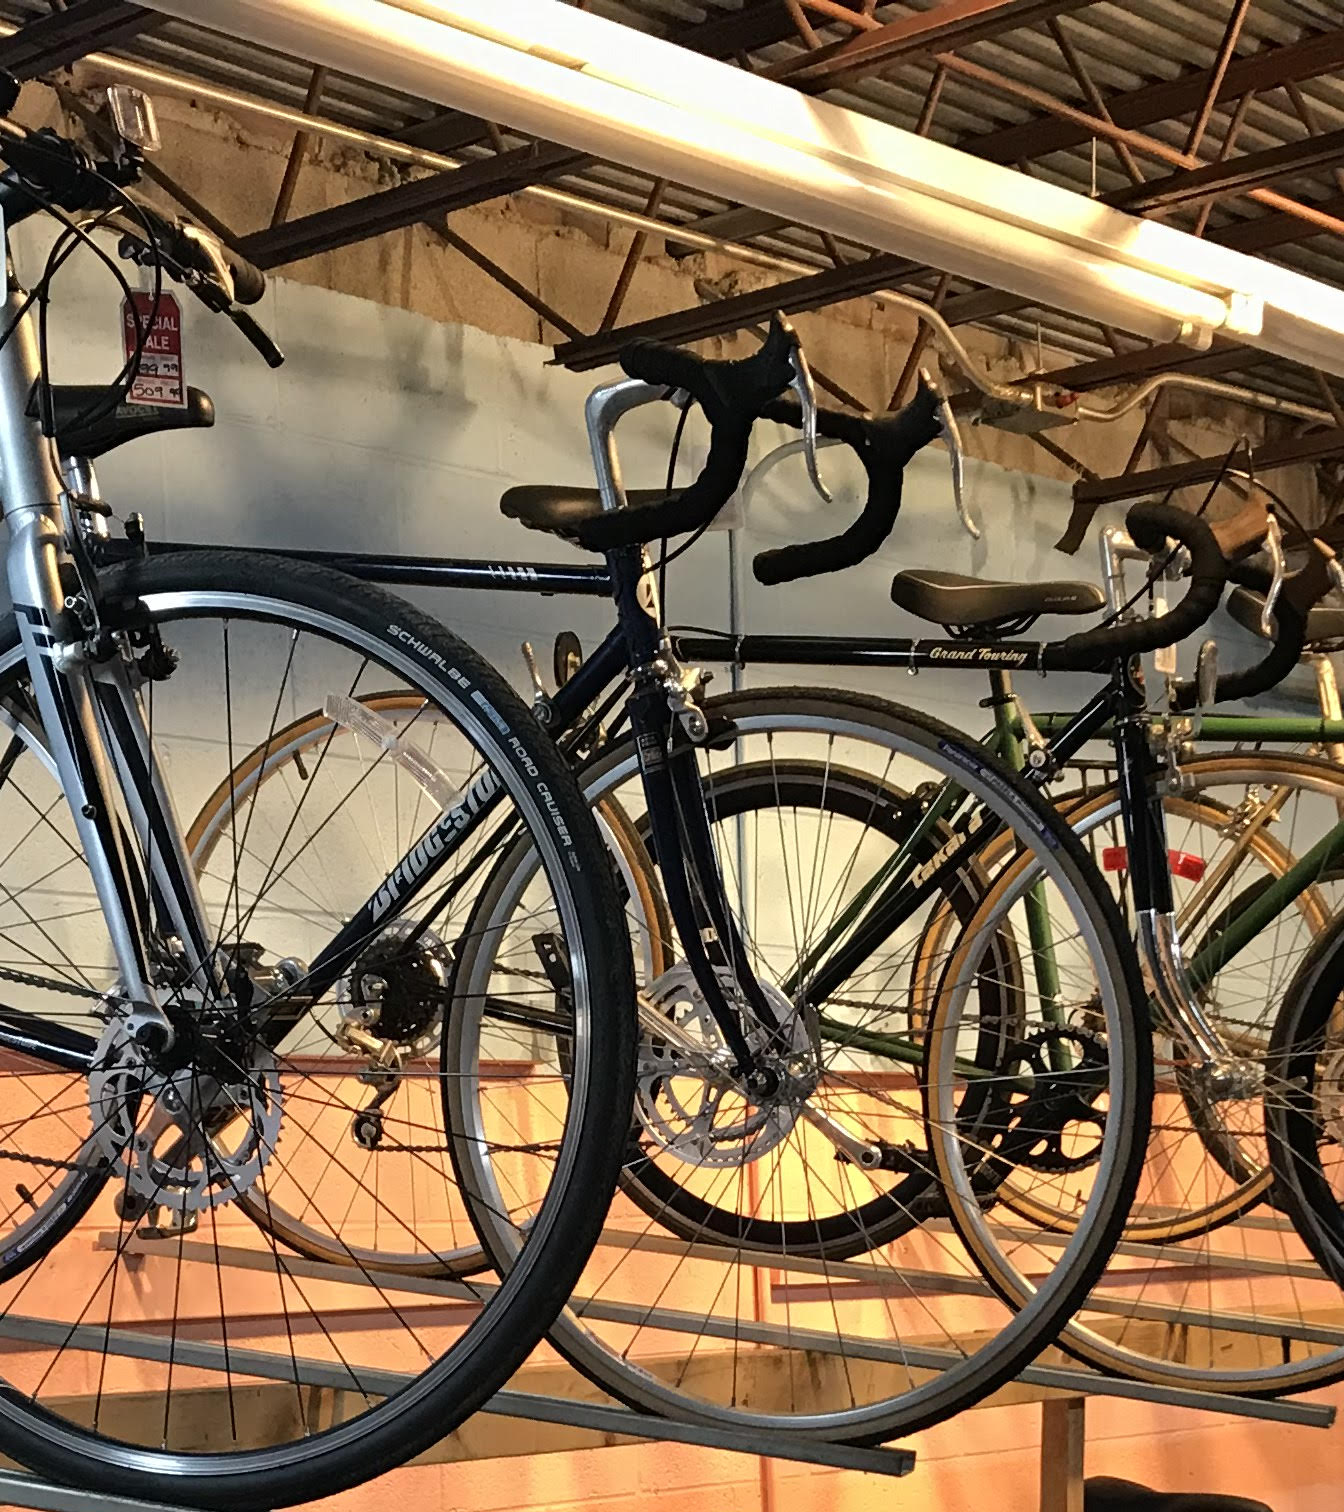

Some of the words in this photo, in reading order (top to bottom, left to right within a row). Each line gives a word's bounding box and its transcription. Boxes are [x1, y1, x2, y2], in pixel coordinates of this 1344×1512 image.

[126, 313, 178, 331] SEIAL
[145, 335, 170, 350] ALE
[929, 646, 976, 660] Grand
[978, 648, 1028, 667] Touring
[386, 624, 472, 690] SCHWALBE
[507, 737, 539, 777] ROAD
[536, 782, 572, 847] CRUISER
